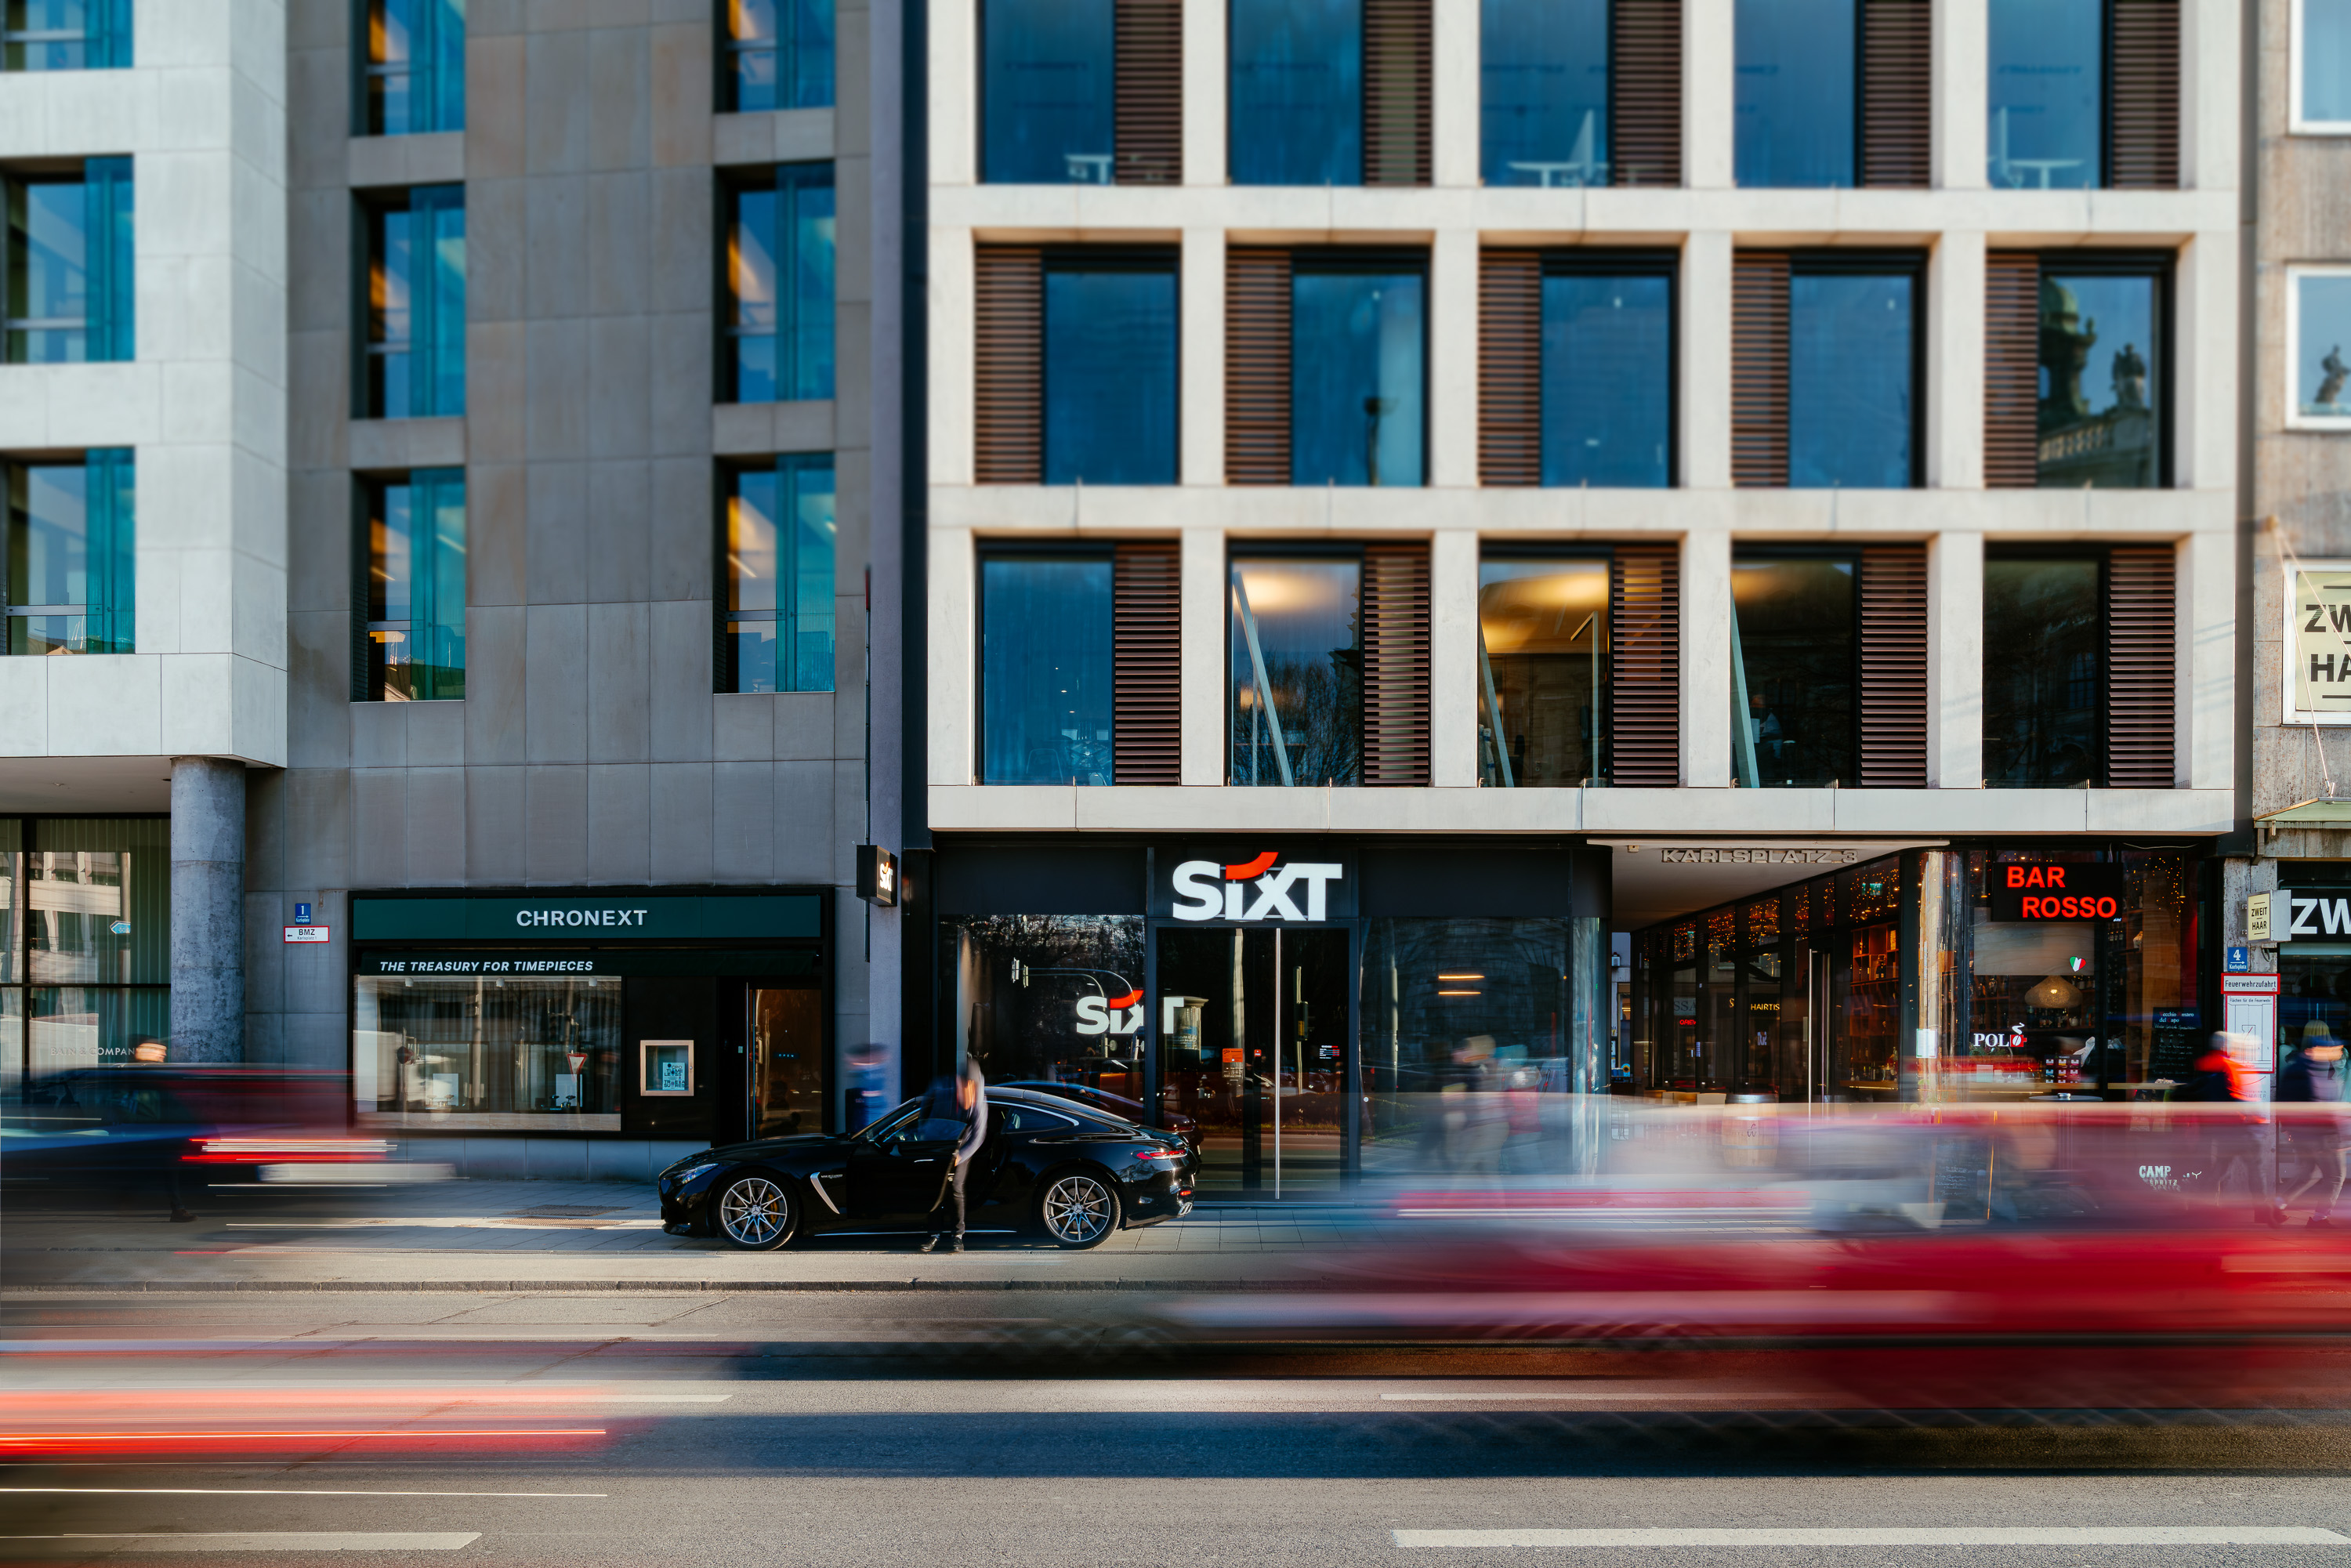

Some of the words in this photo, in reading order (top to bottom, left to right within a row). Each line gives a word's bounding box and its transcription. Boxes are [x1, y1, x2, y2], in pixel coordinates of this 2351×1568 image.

[1662, 849, 1832, 863] KARLSPLATZ
[1842, 849, 1858, 863] 3
[2007, 866, 2066, 888] BAR
[301, 905, 305, 914] 1
[2022, 896, 2117, 918] ROSSO
[2251, 907, 2268, 918] ZWEIT
[516, 910, 647, 926] CHRONEXT
[2251, 921, 2267, 931] HAAR
[2233, 950, 2241, 961] 4
[380, 961, 405, 971] THE
[411, 961, 480, 971] TREASURY
[483, 961, 509, 971] FOR
[514, 961, 593, 971] TIMEPIECES
[2225, 980, 2277, 988] Feuerwehrzufahrt
[50, 1047, 76, 1056] BAIN
[89, 1047, 136, 1056] COMPAN
